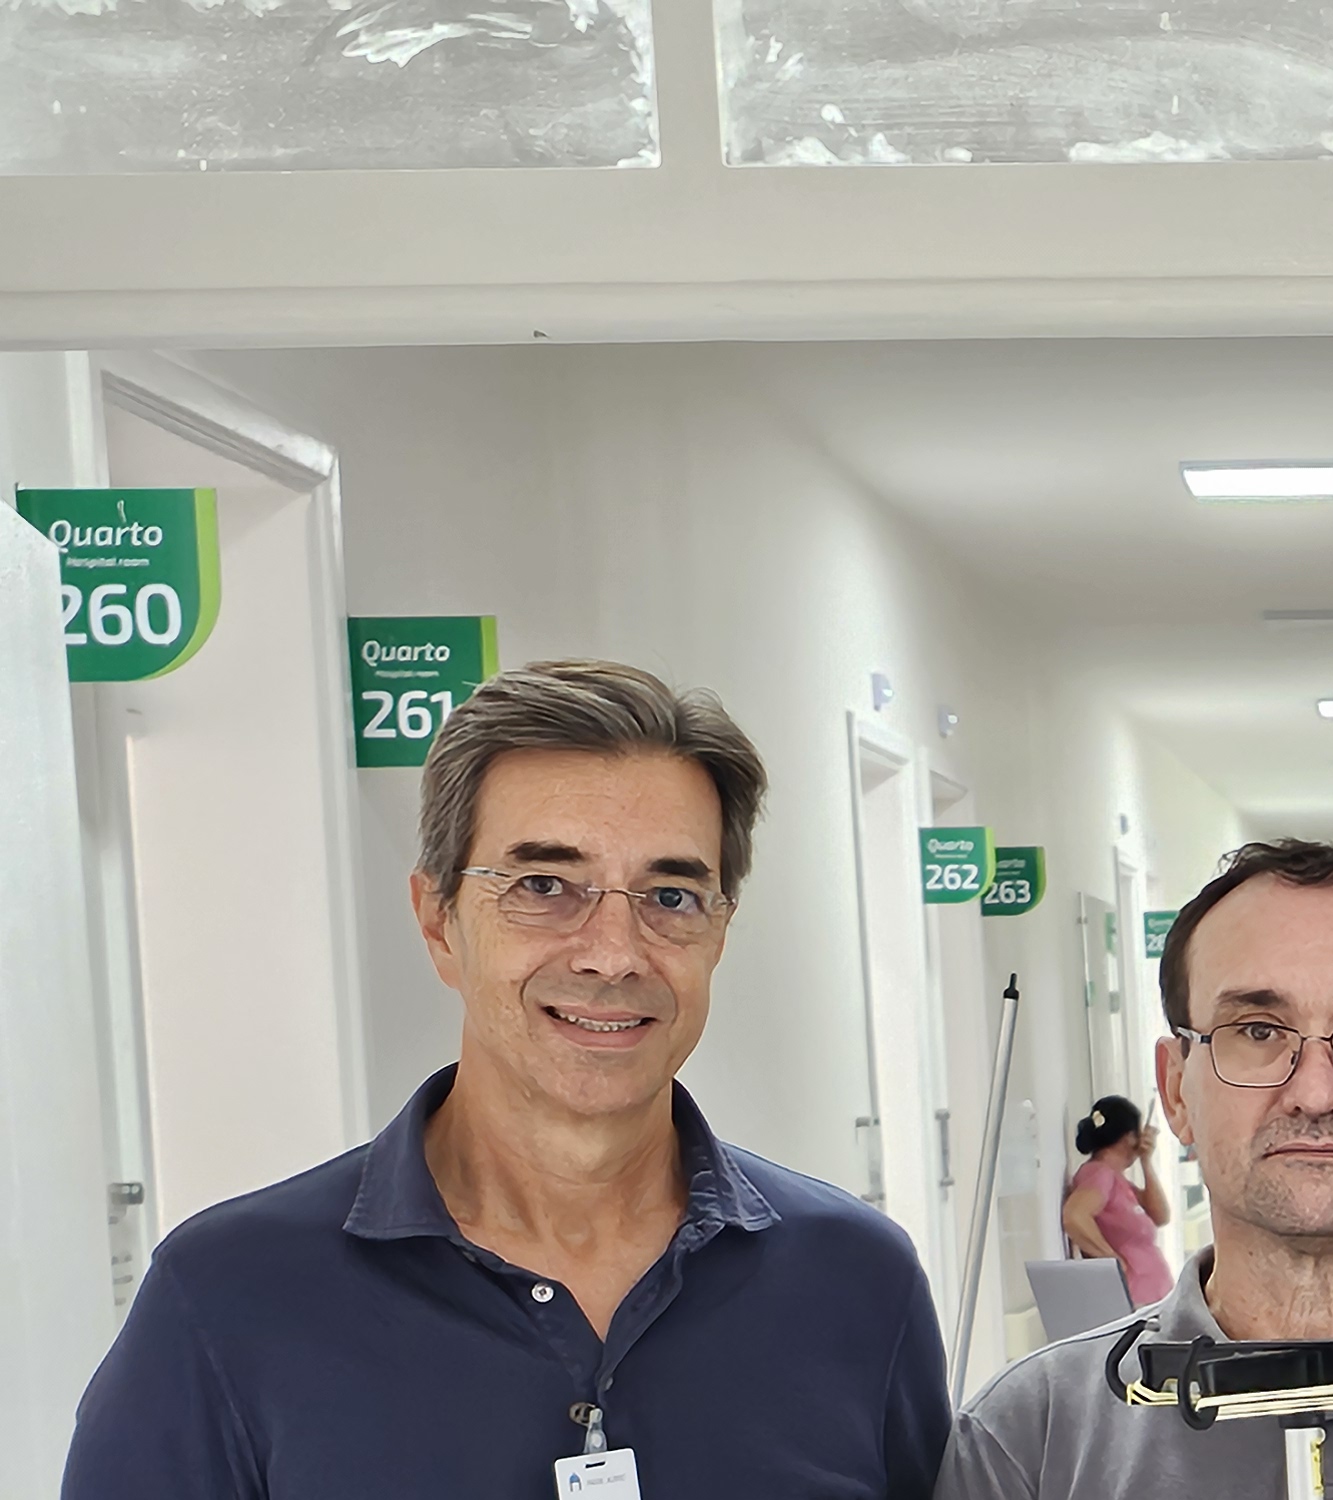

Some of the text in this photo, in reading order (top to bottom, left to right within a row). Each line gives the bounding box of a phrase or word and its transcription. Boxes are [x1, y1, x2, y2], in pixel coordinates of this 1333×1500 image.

[49, 520, 163, 553] Quarto
[61, 583, 182, 646] 260
[362, 640, 451, 666] Quarto
[362, 690, 453, 739] 261
[925, 864, 979, 890] 262
[984, 880, 1031, 904] 263
